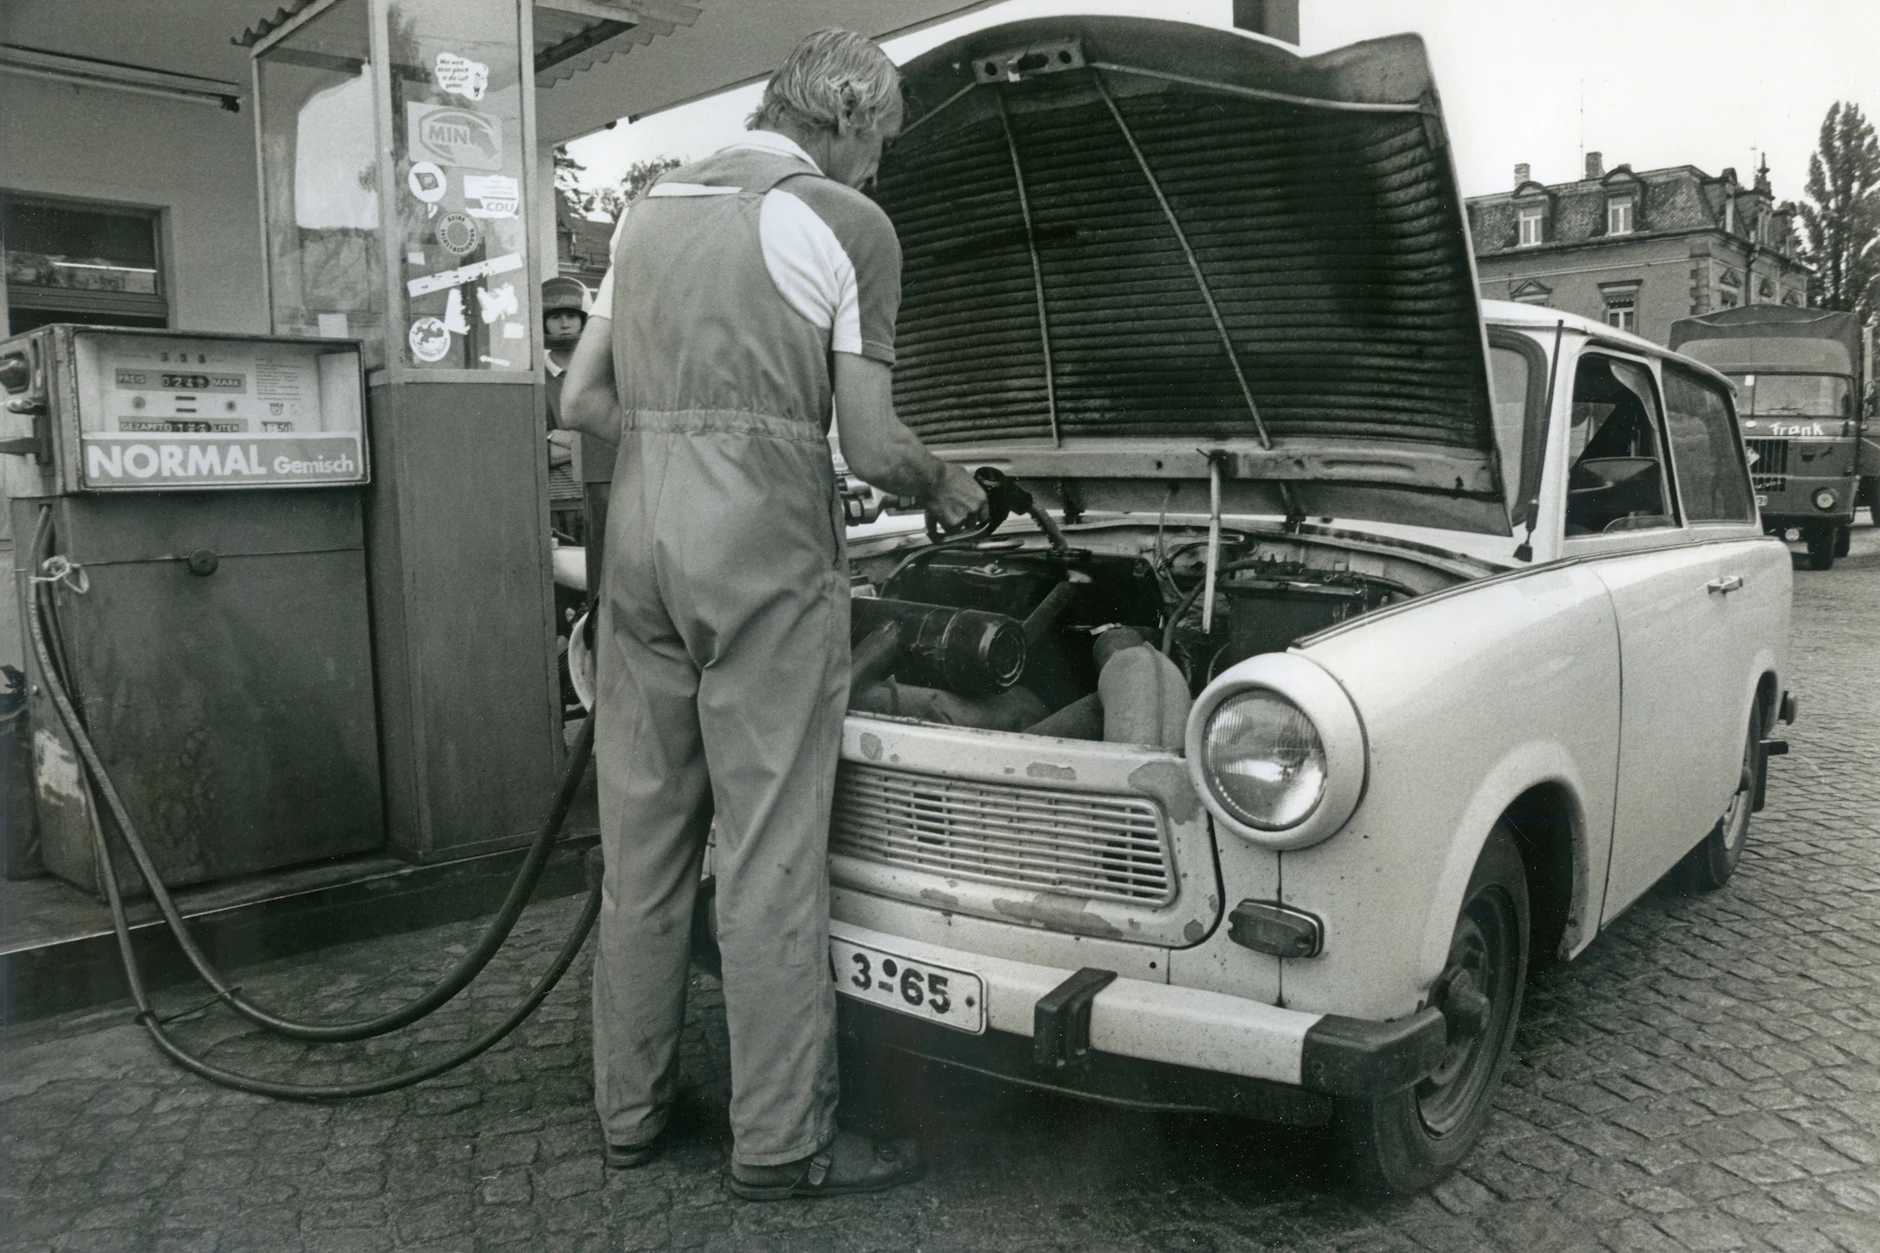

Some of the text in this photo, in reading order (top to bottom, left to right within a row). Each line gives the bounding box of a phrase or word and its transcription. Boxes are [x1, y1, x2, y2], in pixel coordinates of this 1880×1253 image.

[486, 203, 514, 212] CDU
[118, 374, 146, 385] PREIS
[212, 378, 241, 389] MARK
[120, 422, 165, 433] GEZAPFT
[213, 424, 239, 433] LITER
[1769, 421, 1824, 436] Frank
[87, 444, 355, 479] NORMAL Gemisch
